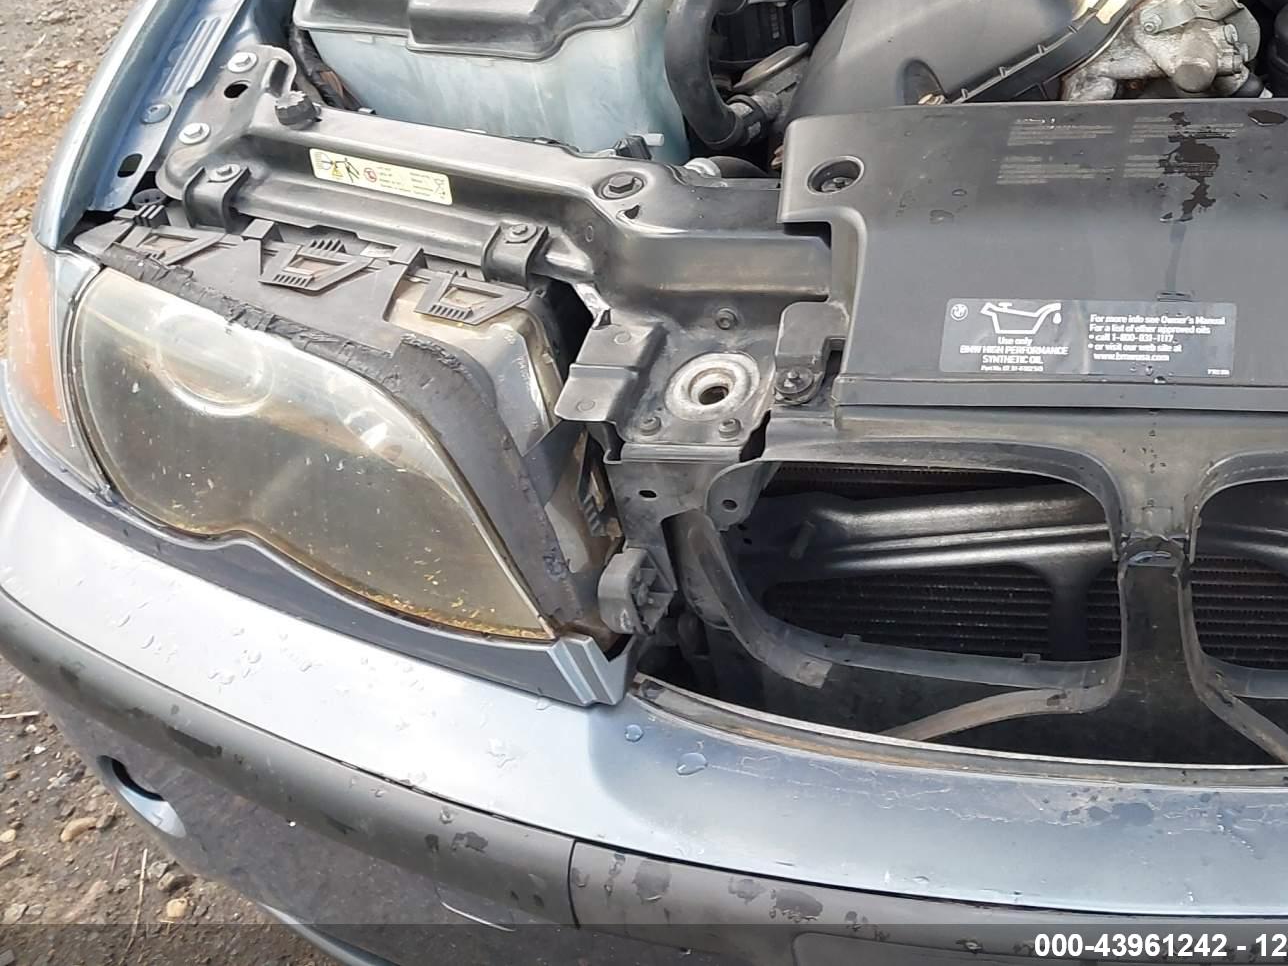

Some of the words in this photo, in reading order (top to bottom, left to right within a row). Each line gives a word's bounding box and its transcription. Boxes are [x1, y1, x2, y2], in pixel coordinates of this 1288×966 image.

[1090, 314, 1105, 323] For
[1105, 315, 1128, 323] more
[1128, 314, 1144, 323] info
[1160, 315, 1195, 324] Owner's
[1089, 324, 1104, 332] For
[1111, 324, 1125, 333] list
[1125, 324, 1135, 333] of
[1135, 324, 1156, 333] other
[1157, 325, 1196, 335] approved
[997, 337, 1014, 345] Use
[1015, 337, 1033, 347] only
[959, 345, 982, 354] BMW
[982, 345, 1004, 354] HIGH
[1005, 346, 1069, 355] PERFORMANCE
[1105, 343, 1122, 351] visit
[1138, 343, 1157, 352] web
[1157, 343, 1172, 352] site
[1173, 344, 1183, 352] at
[982, 355, 1028, 364] SYNTHETIC
[1029, 355, 1043, 364] OIL
